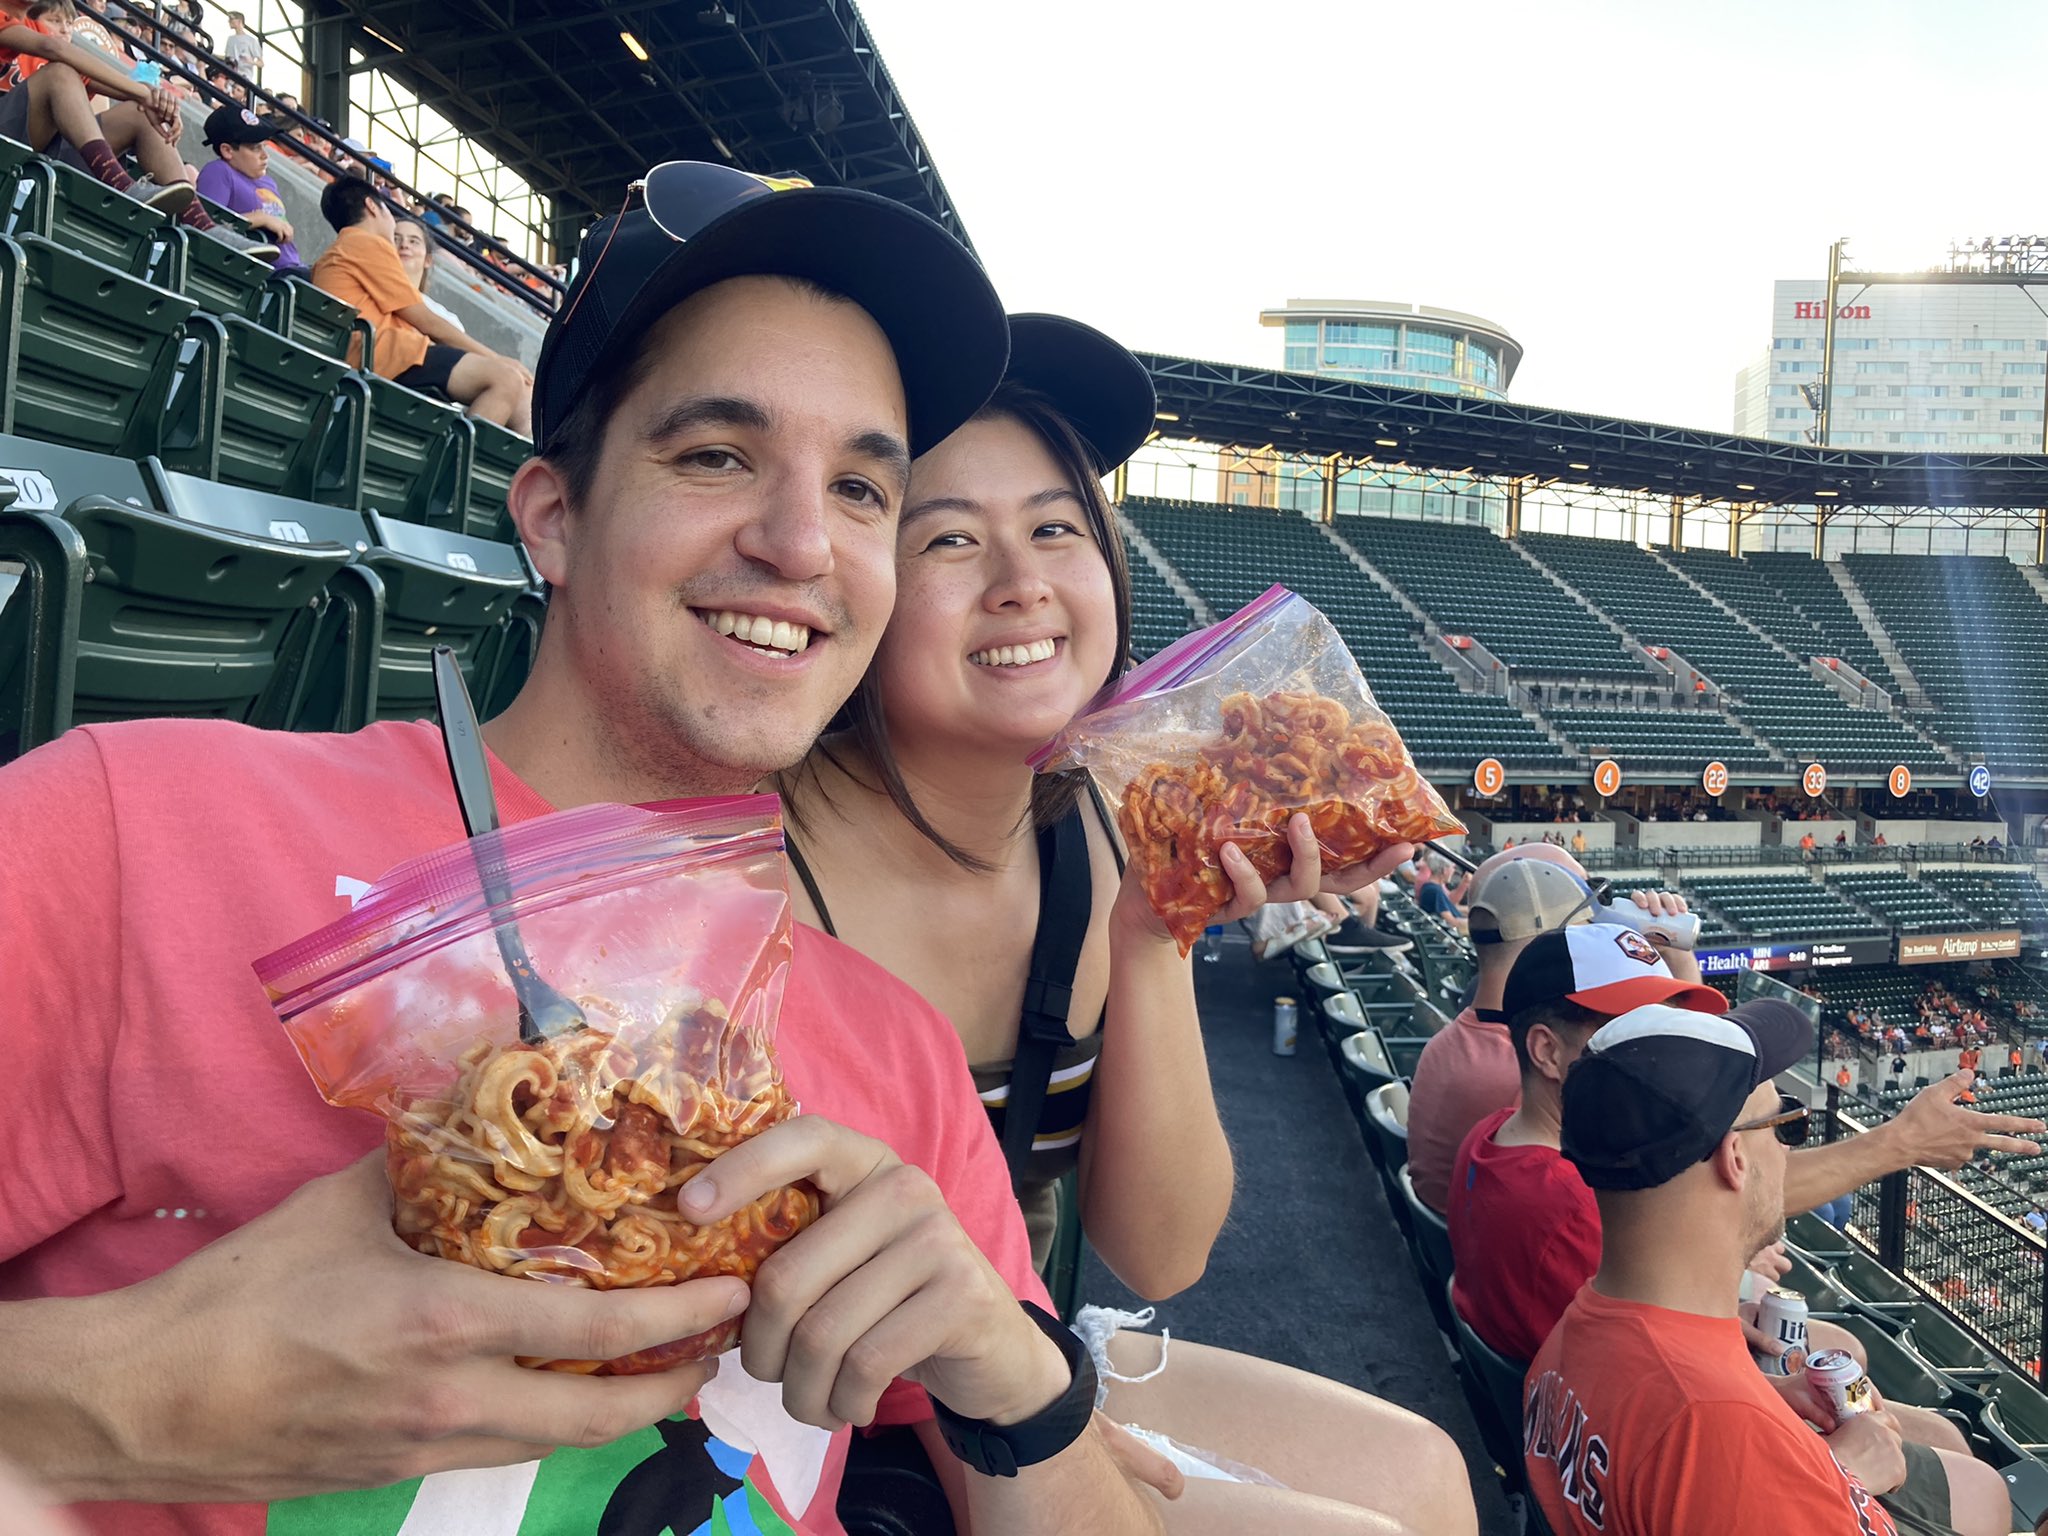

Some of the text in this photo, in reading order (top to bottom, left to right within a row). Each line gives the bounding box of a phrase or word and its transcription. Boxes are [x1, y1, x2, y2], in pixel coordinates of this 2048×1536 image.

[1484, 766, 1496, 788] 5
[1602, 768, 1613, 788] 4
[1708, 769, 1725, 788] 22
[1807, 771, 1823, 789] 33
[1897, 773, 1906, 790] 8
[1973, 772, 1988, 790] 42
[1753, 947, 1772, 958] MIN
[1941, 938, 1977, 956] Airtemp
[1707, 952, 1749, 971] Health
[1752, 959, 1770, 971] ARI
[1777, 1319, 1807, 1344] Lit
